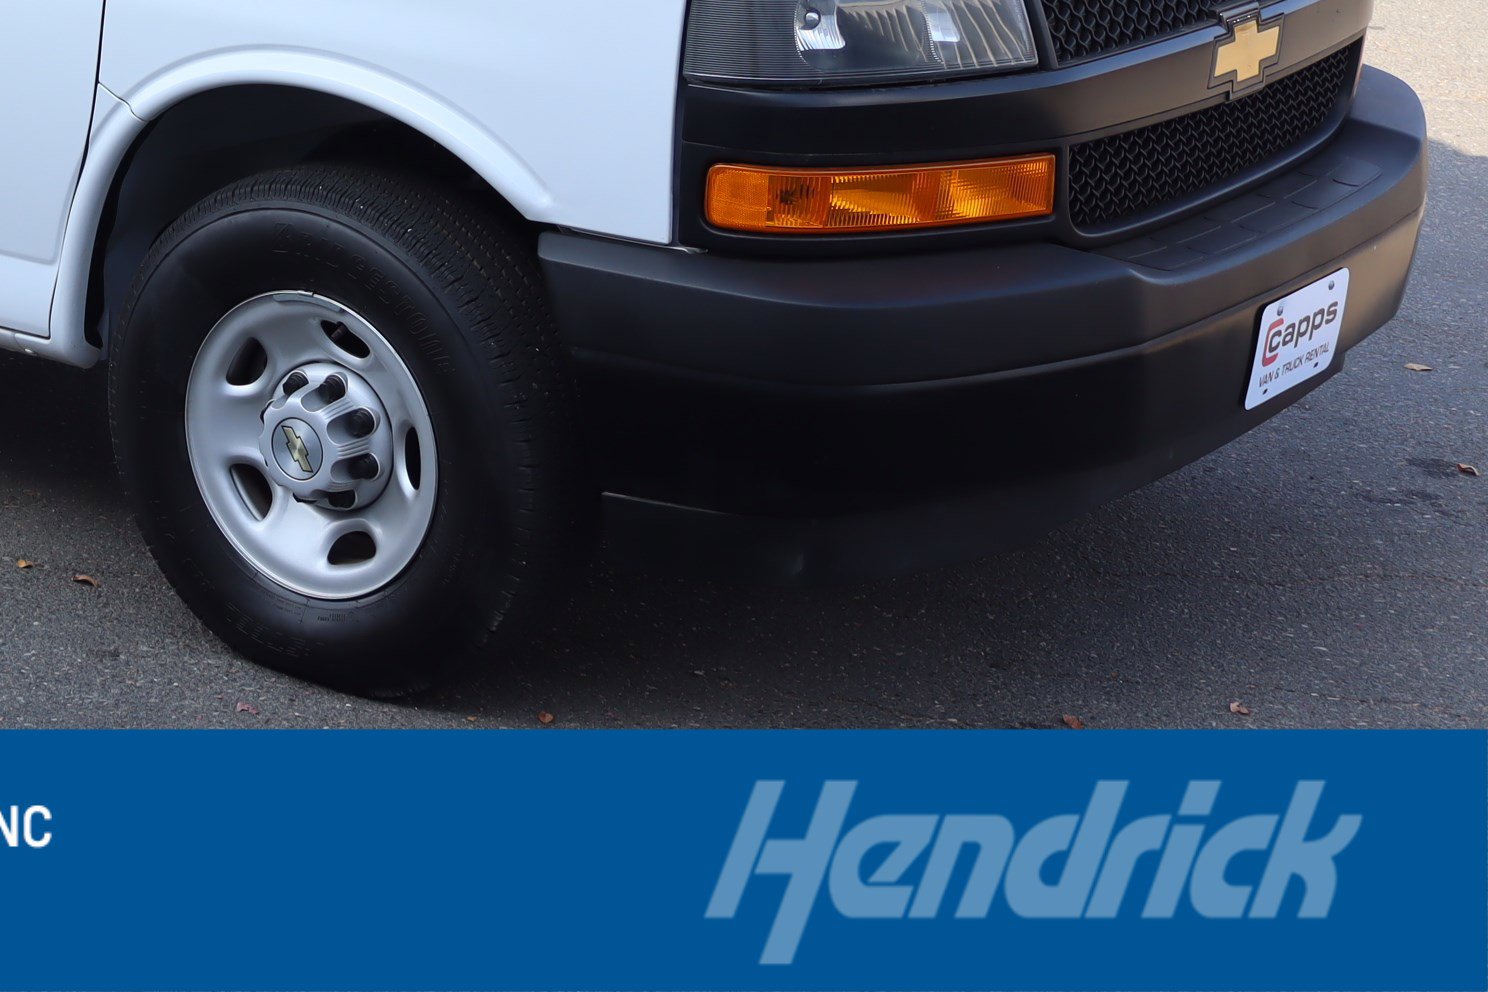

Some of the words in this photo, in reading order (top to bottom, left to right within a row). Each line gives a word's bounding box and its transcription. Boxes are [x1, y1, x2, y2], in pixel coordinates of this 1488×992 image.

[1259, 370, 1275, 387] VAN
[1281, 355, 1305, 376] TRUCK
[1304, 341, 1330, 364] RENTAL
